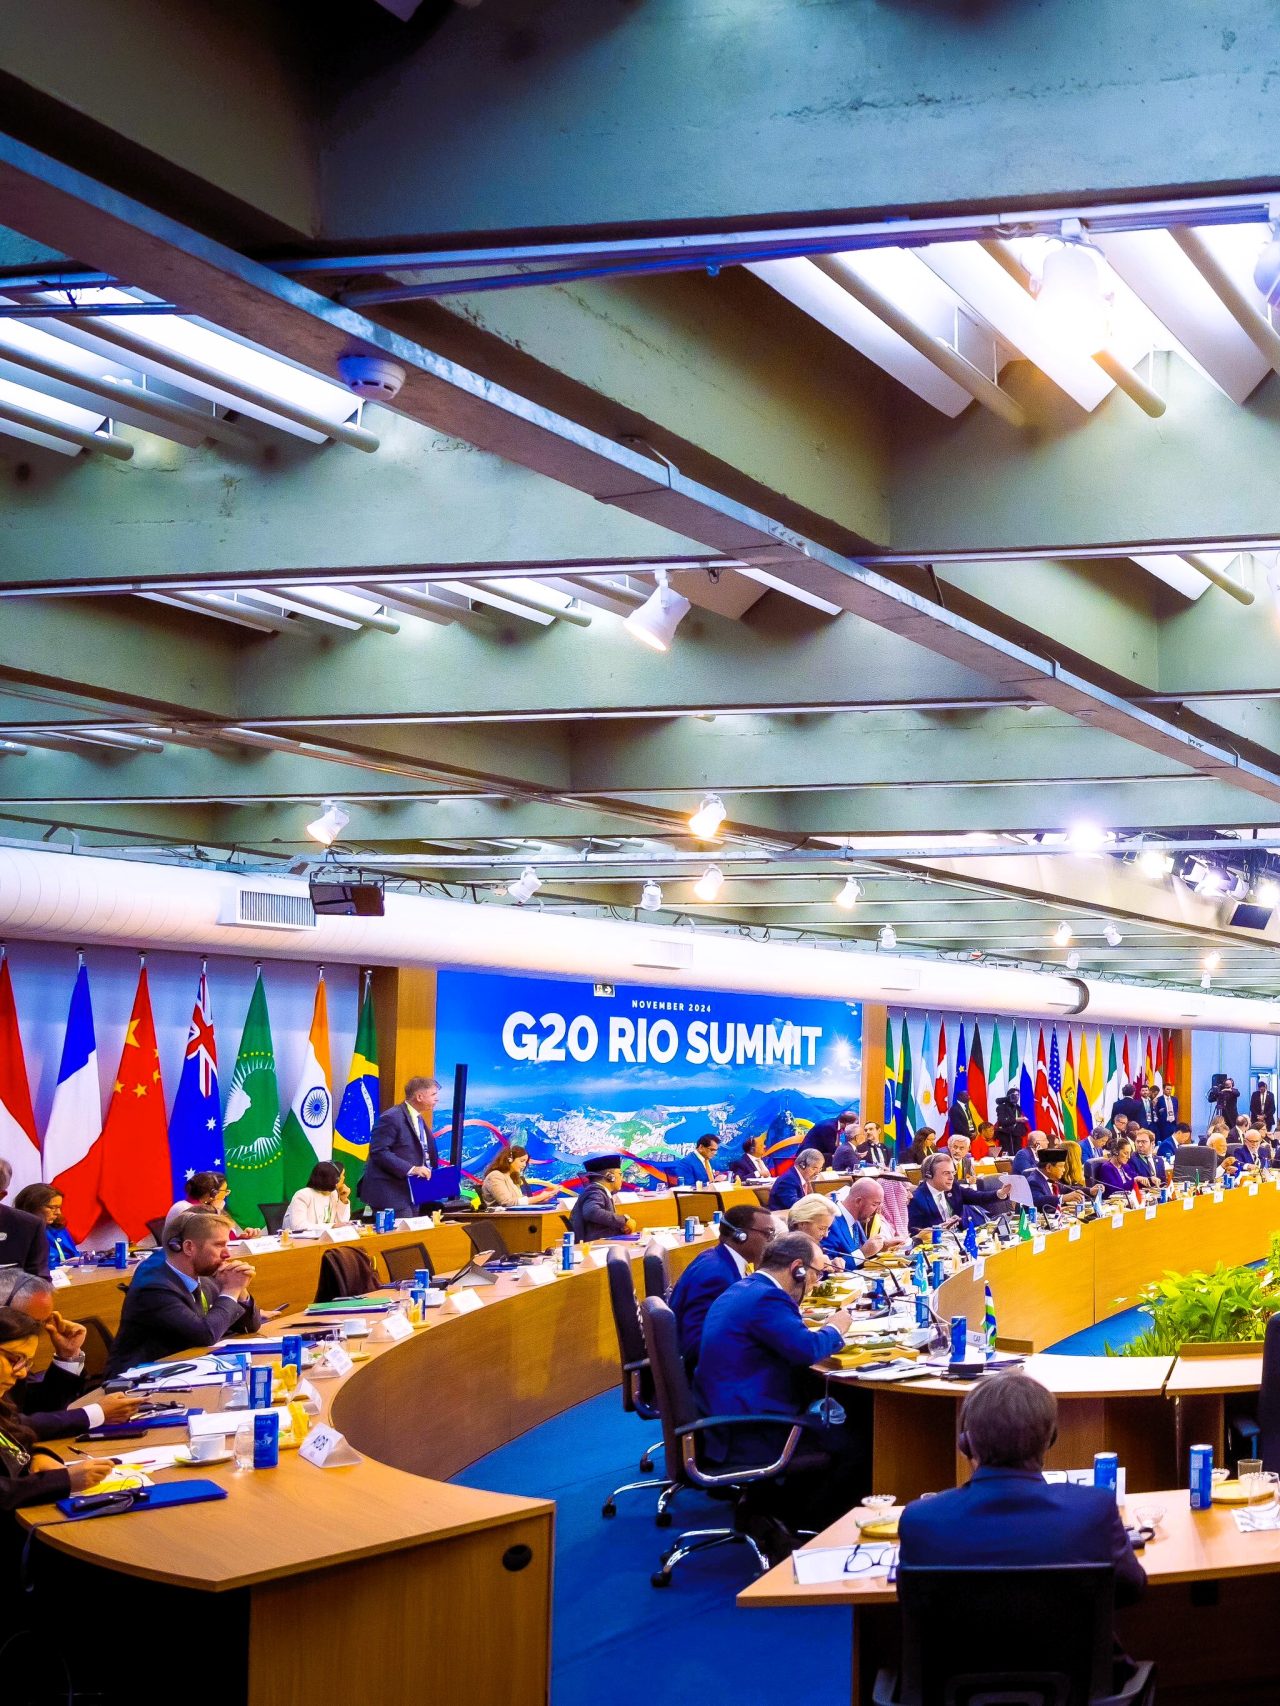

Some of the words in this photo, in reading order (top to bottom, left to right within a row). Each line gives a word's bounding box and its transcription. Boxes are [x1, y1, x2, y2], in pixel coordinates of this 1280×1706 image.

[632, 1000, 684, 1011] NOVEMBER
[688, 1004, 711, 1012] 2024
[502, 1011, 599, 1062] G20
[608, 1016, 679, 1064] RIO
[685, 1020, 823, 1066] SUMMIT
